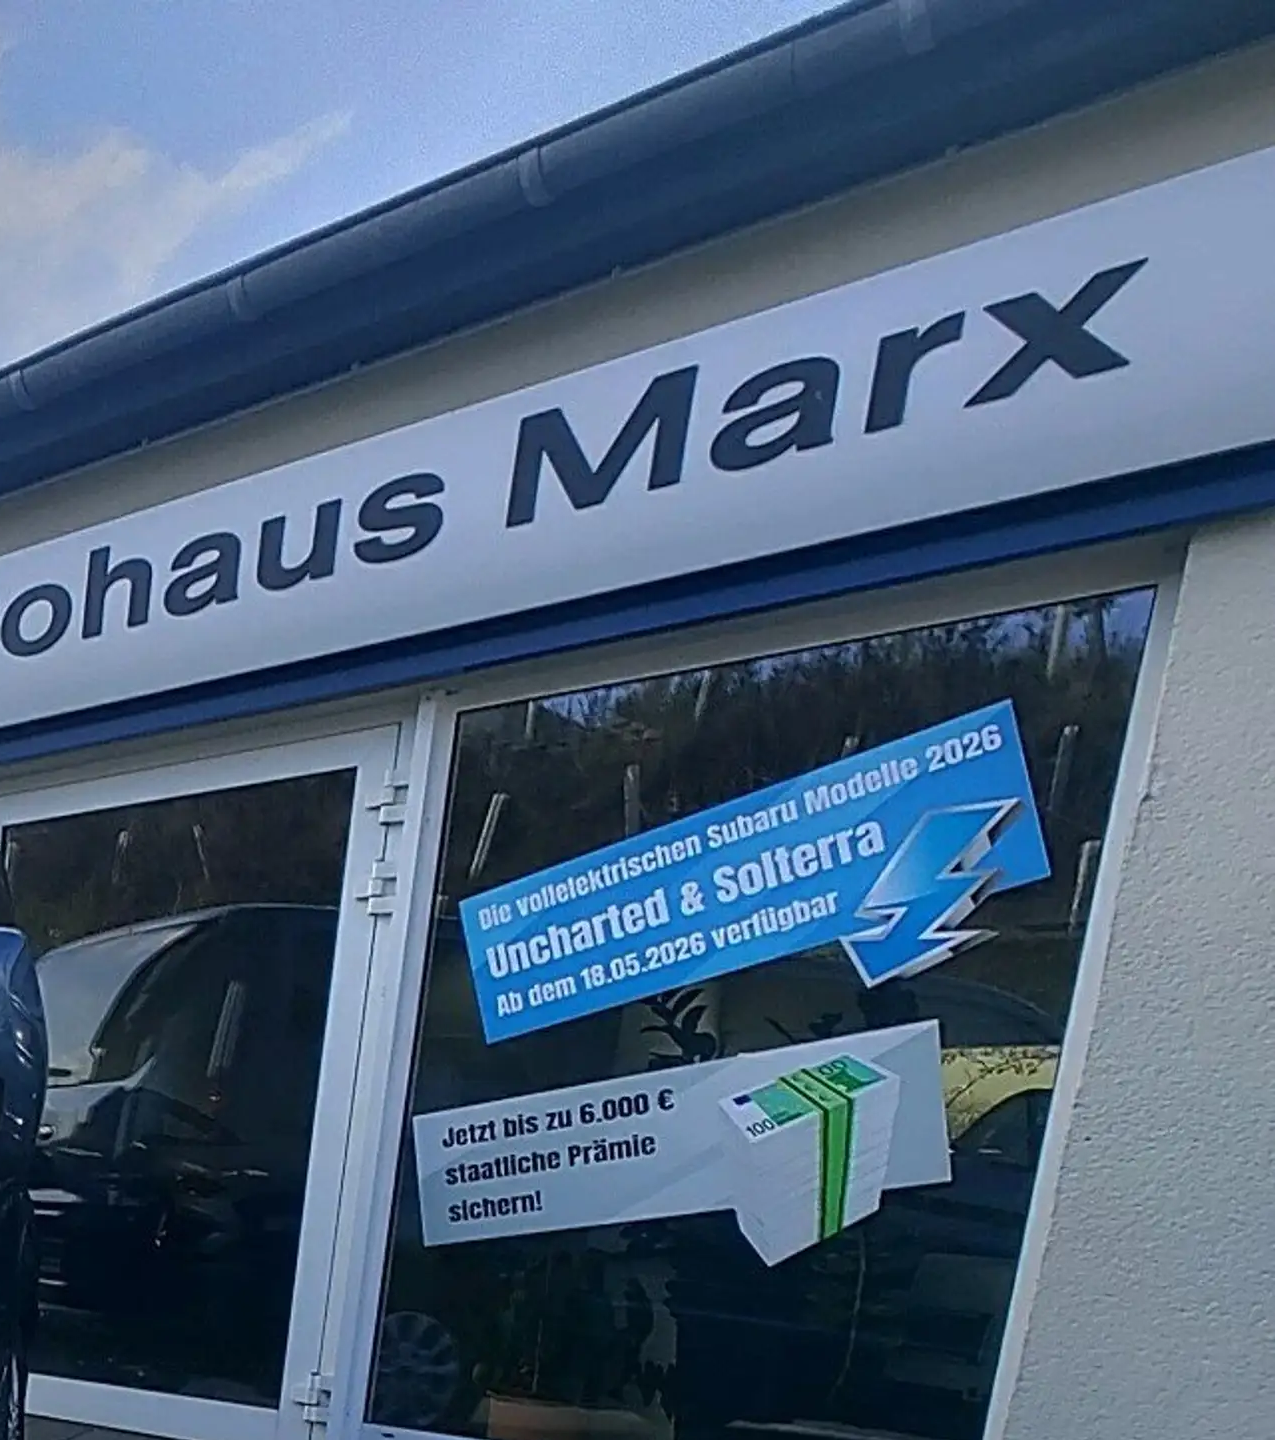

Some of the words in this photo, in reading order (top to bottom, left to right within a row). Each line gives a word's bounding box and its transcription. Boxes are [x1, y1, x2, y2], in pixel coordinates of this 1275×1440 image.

[505, 256, 1150, 529] Marx
[478, 902, 512, 930] Die
[516, 835, 702, 917] vollelektrischen
[706, 800, 799, 849] Subaru
[802, 757, 918, 815] Modelle
[924, 723, 1002, 773] 2026
[485, 887, 671, 979] Uncharted
[680, 880, 706, 917] &
[713, 820, 886, 903] Solterra
[496, 992, 524, 1018] Ab
[529, 975, 577, 1007] dem
[580, 931, 707, 990] 18.05.2026
[710, 891, 839, 949] verfügbar
[442, 1120, 497, 1149] Jetzt
[503, 1113, 539, 1138] bis
[545, 1108, 573, 1132] zu
[579, 1093, 650, 1126] 6.000
[657, 1088, 675, 1112] €
[445, 1150, 561, 1186] staatliche
[567, 1133, 657, 1167] Prämie
[745, 1118, 775, 1138] 100
[448, 1190, 543, 1223] sichern!
